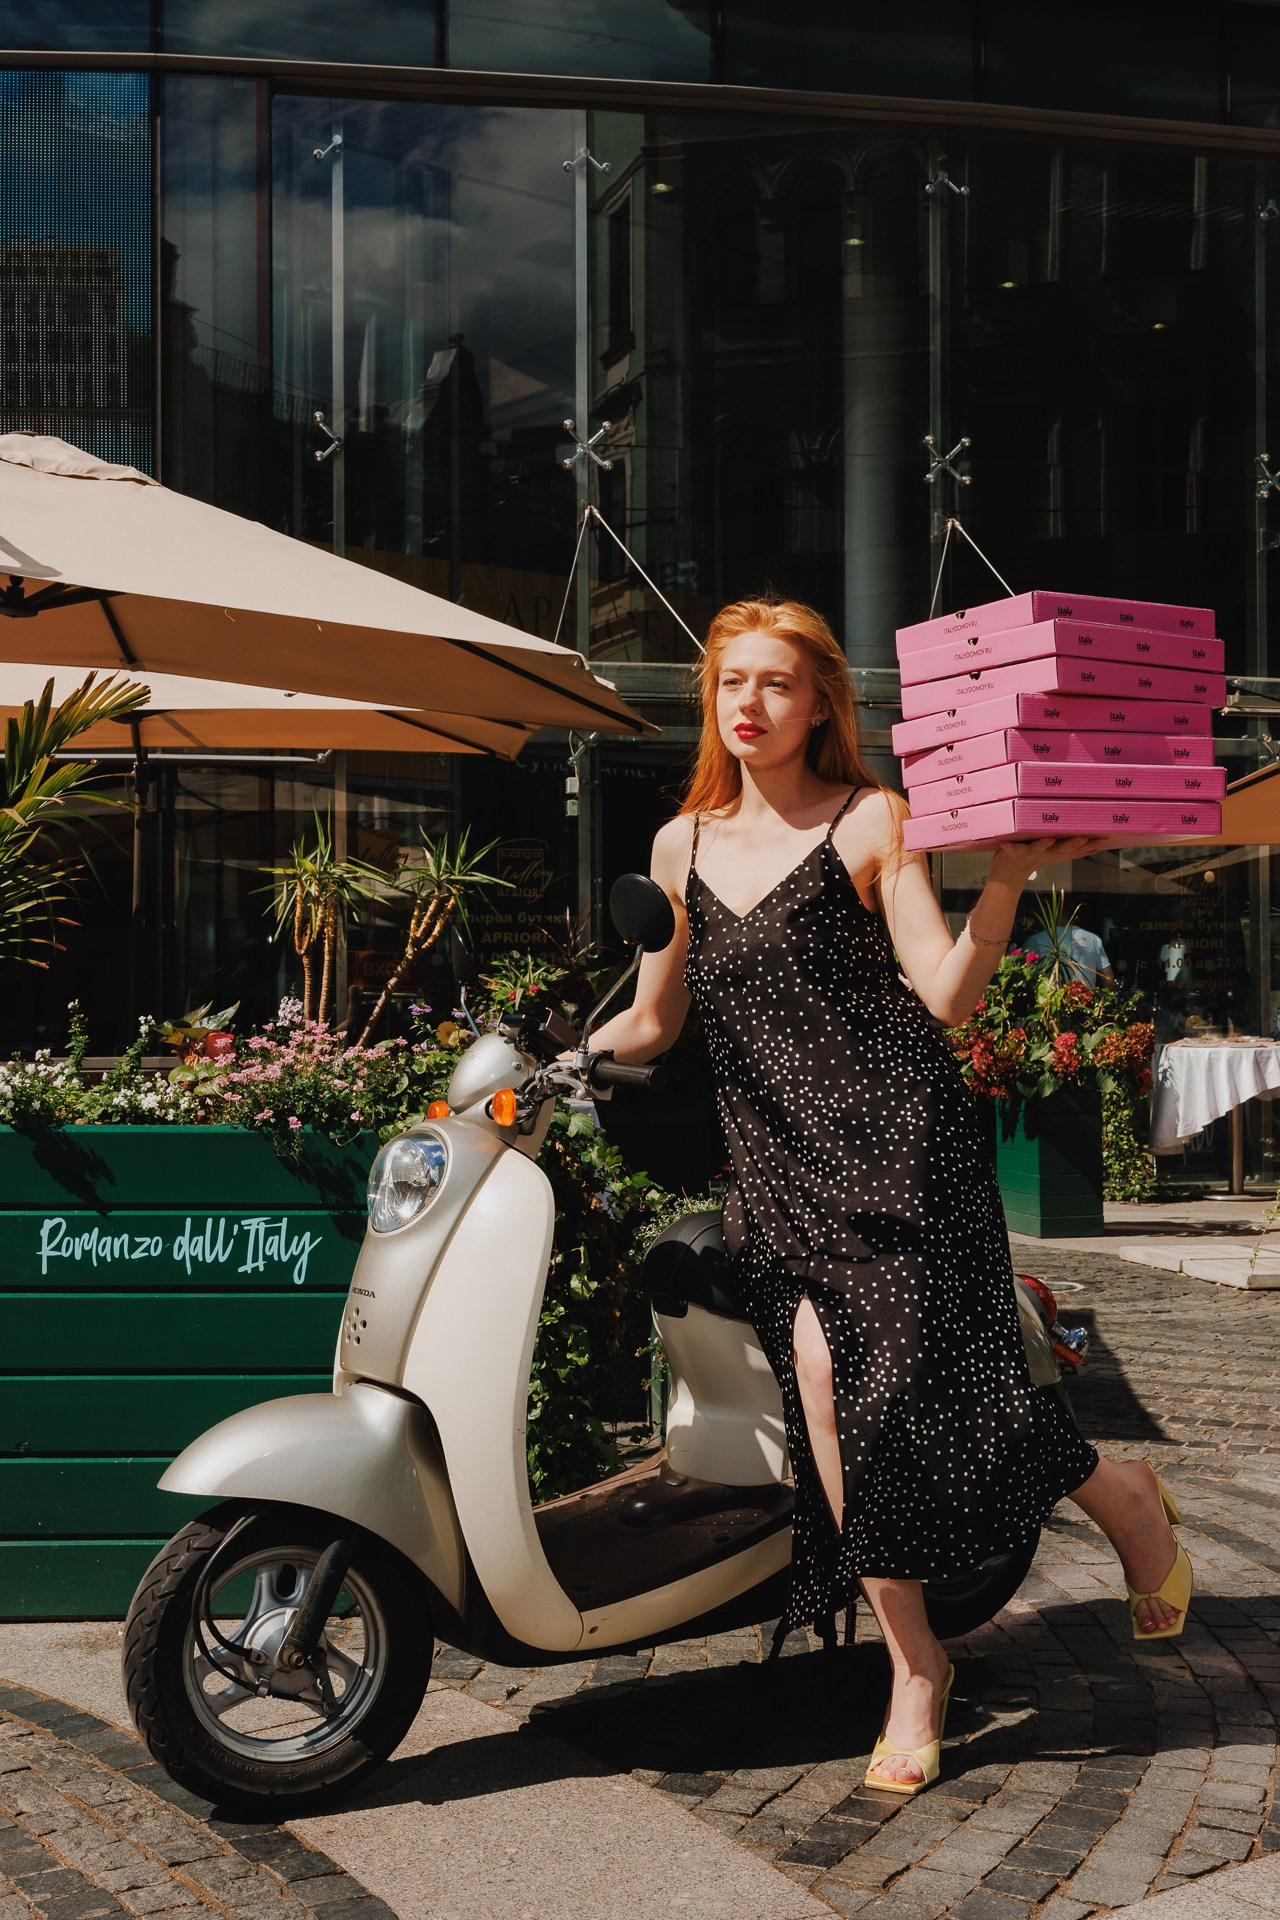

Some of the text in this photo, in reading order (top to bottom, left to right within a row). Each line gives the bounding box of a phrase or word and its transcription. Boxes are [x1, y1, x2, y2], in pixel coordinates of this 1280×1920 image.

[1057, 607, 1073, 617] italy
[1119, 613, 1135, 623] italy
[944, 620, 978, 634] ITALYDOMOY.RU
[1179, 619, 1194, 629] italy
[1078, 635, 1093, 646] italy
[1136, 642, 1151, 653] italy
[954, 647, 993, 661] ITALYDOMOY.RU
[1192, 649, 1206, 659] italy
[1080, 671, 1096, 682] italy
[1138, 677, 1153, 689] italy
[956, 682, 995, 696] ITALYDOMOY.RU
[1193, 684, 1208, 694] italy
[1043, 708, 1061, 718] italy
[1109, 711, 1126, 722] italy
[1173, 716, 1189, 726] italy
[1033, 743, 1051, 754] italy
[1104, 746, 1121, 756] italy
[1173, 748, 1191, 758] italy
[1044, 776, 1063, 786] italy
[1115, 777, 1133, 788] italy
[1184, 778, 1202, 789] italy
[1041, 812, 1060, 823] italy
[1112, 813, 1130, 824] italy
[1181, 814, 1198, 825] italy
[36, 1217, 163, 1275] Romanzo
